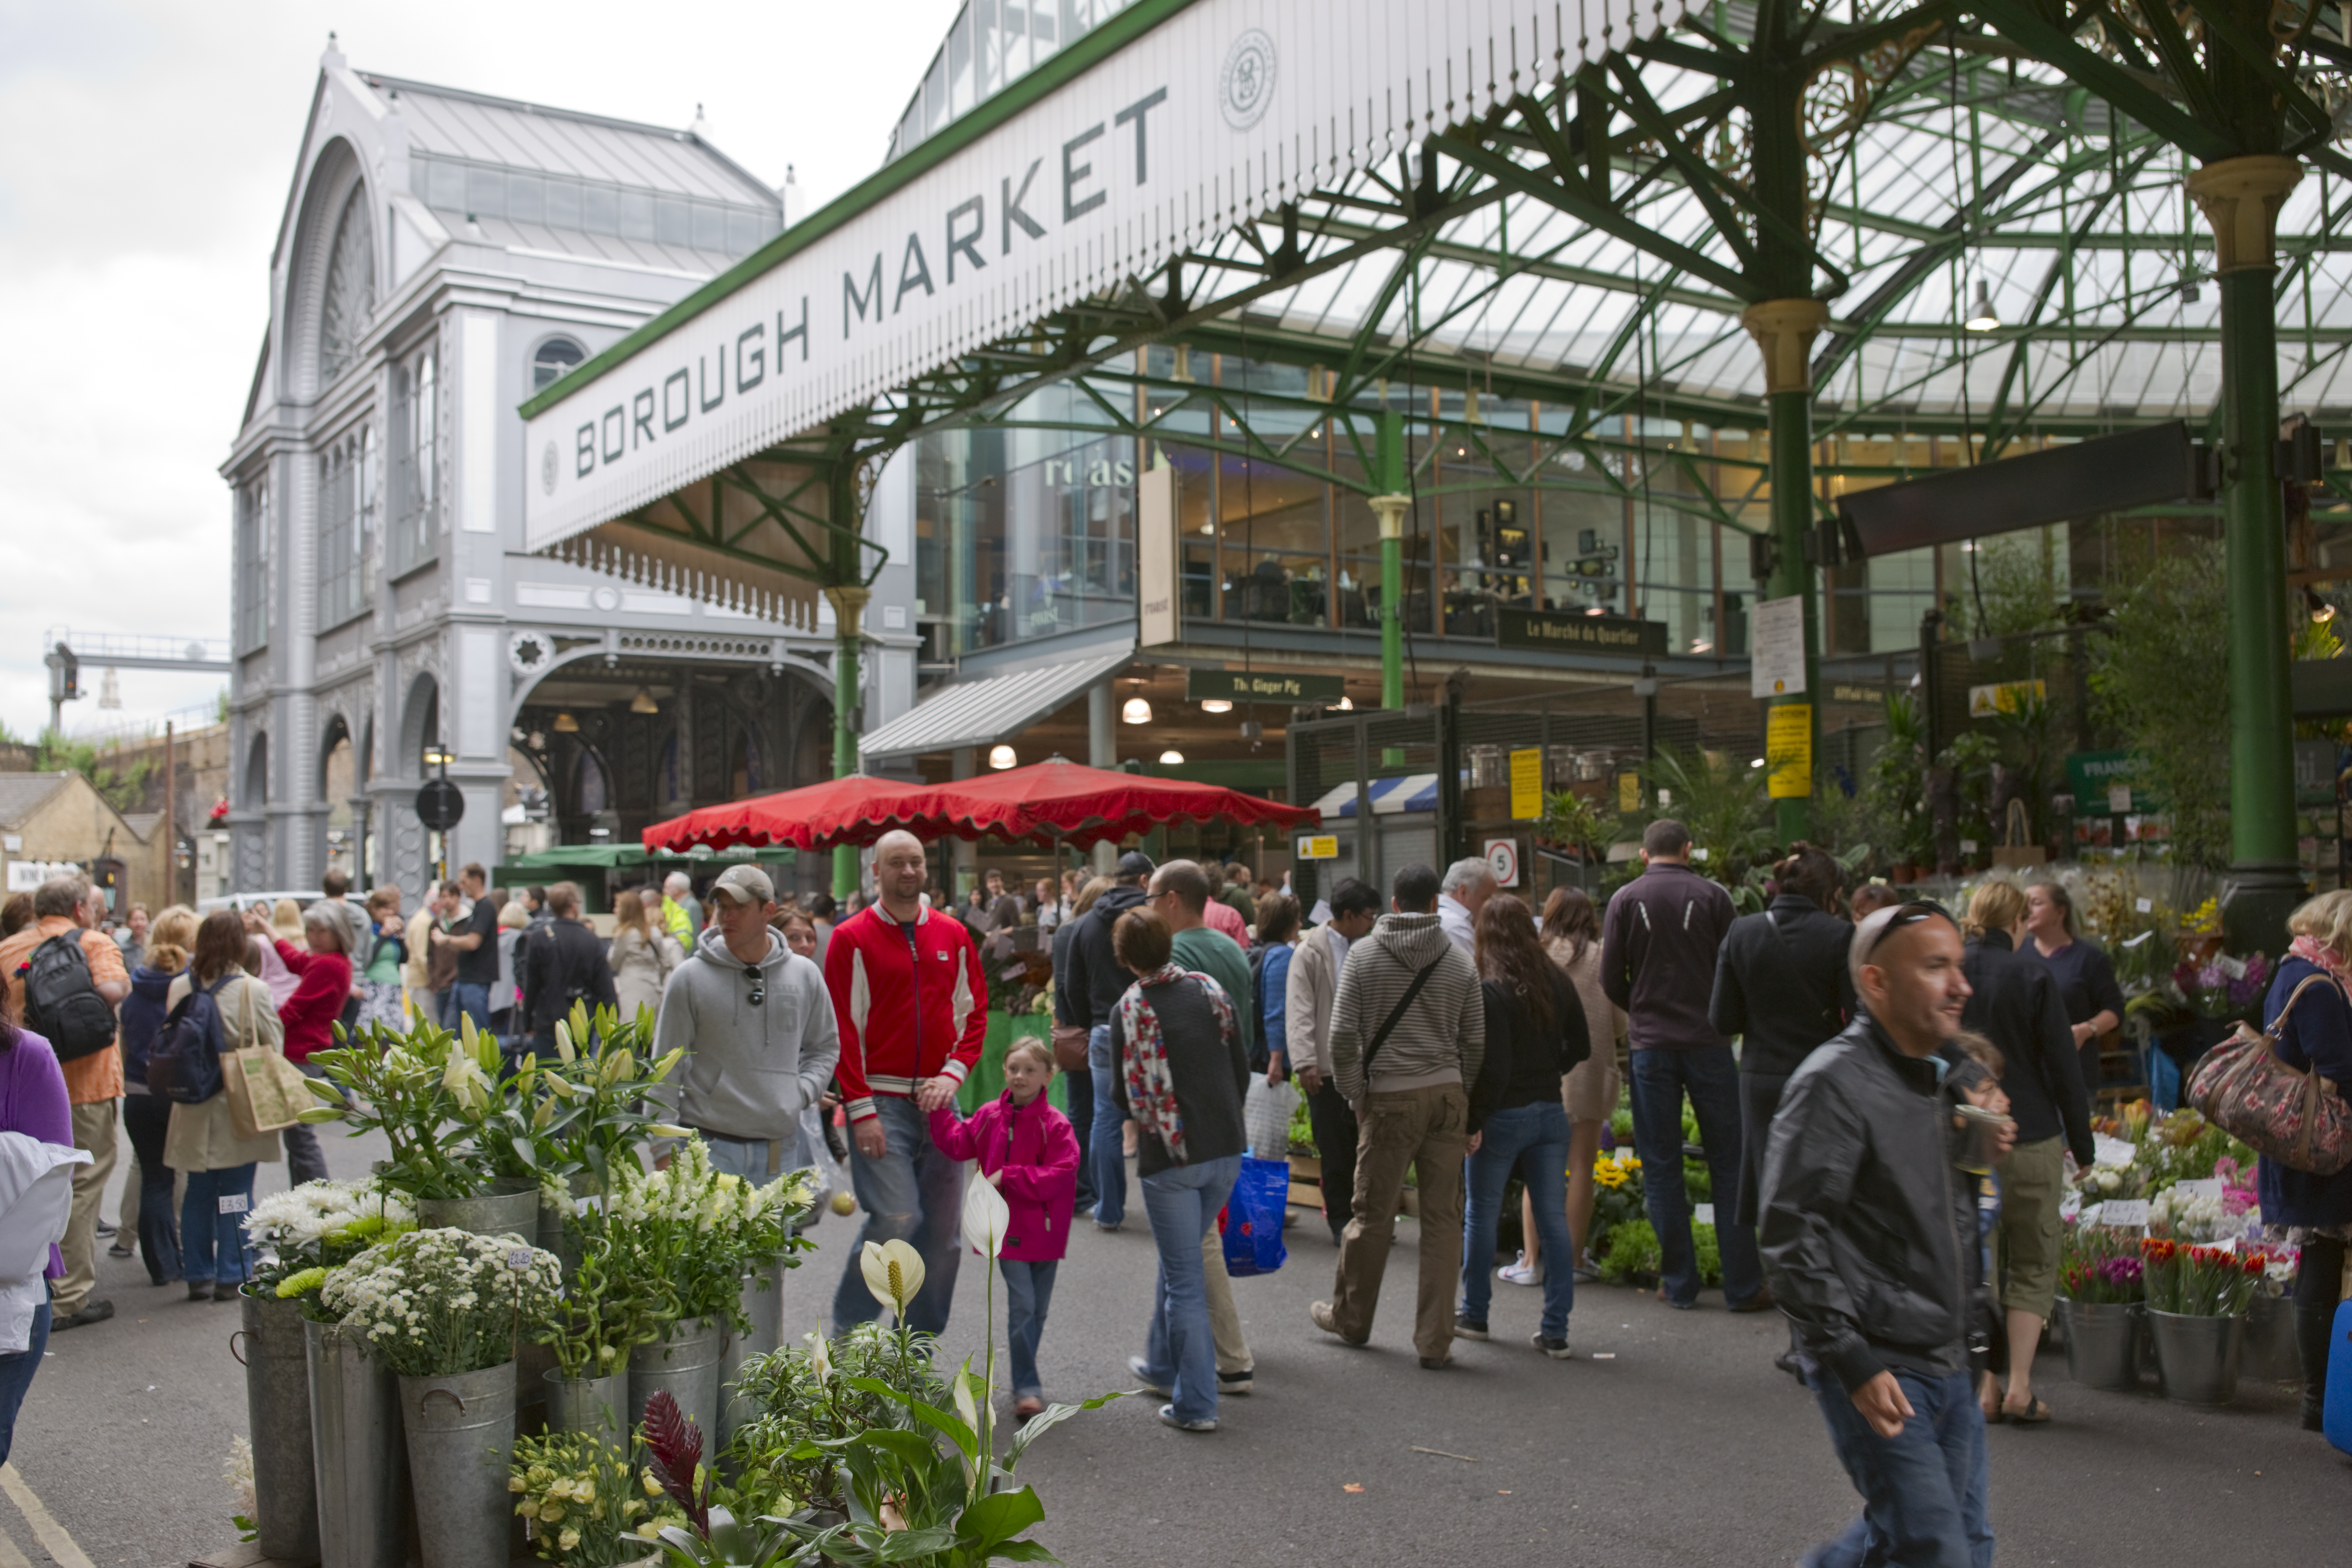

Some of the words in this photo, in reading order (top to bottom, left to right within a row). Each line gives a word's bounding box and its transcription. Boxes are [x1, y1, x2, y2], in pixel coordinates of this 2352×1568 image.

[576, 296, 809, 478] BOROUGH
[842, 85, 1168, 339] MARKET
[1526, 620, 1540, 637] Le
[1597, 625, 1639, 645] Quartier
[1252, 677, 1283, 695] Ginger
[1284, 679, 1301, 696] Pig
[1498, 855, 1506, 871] 5
